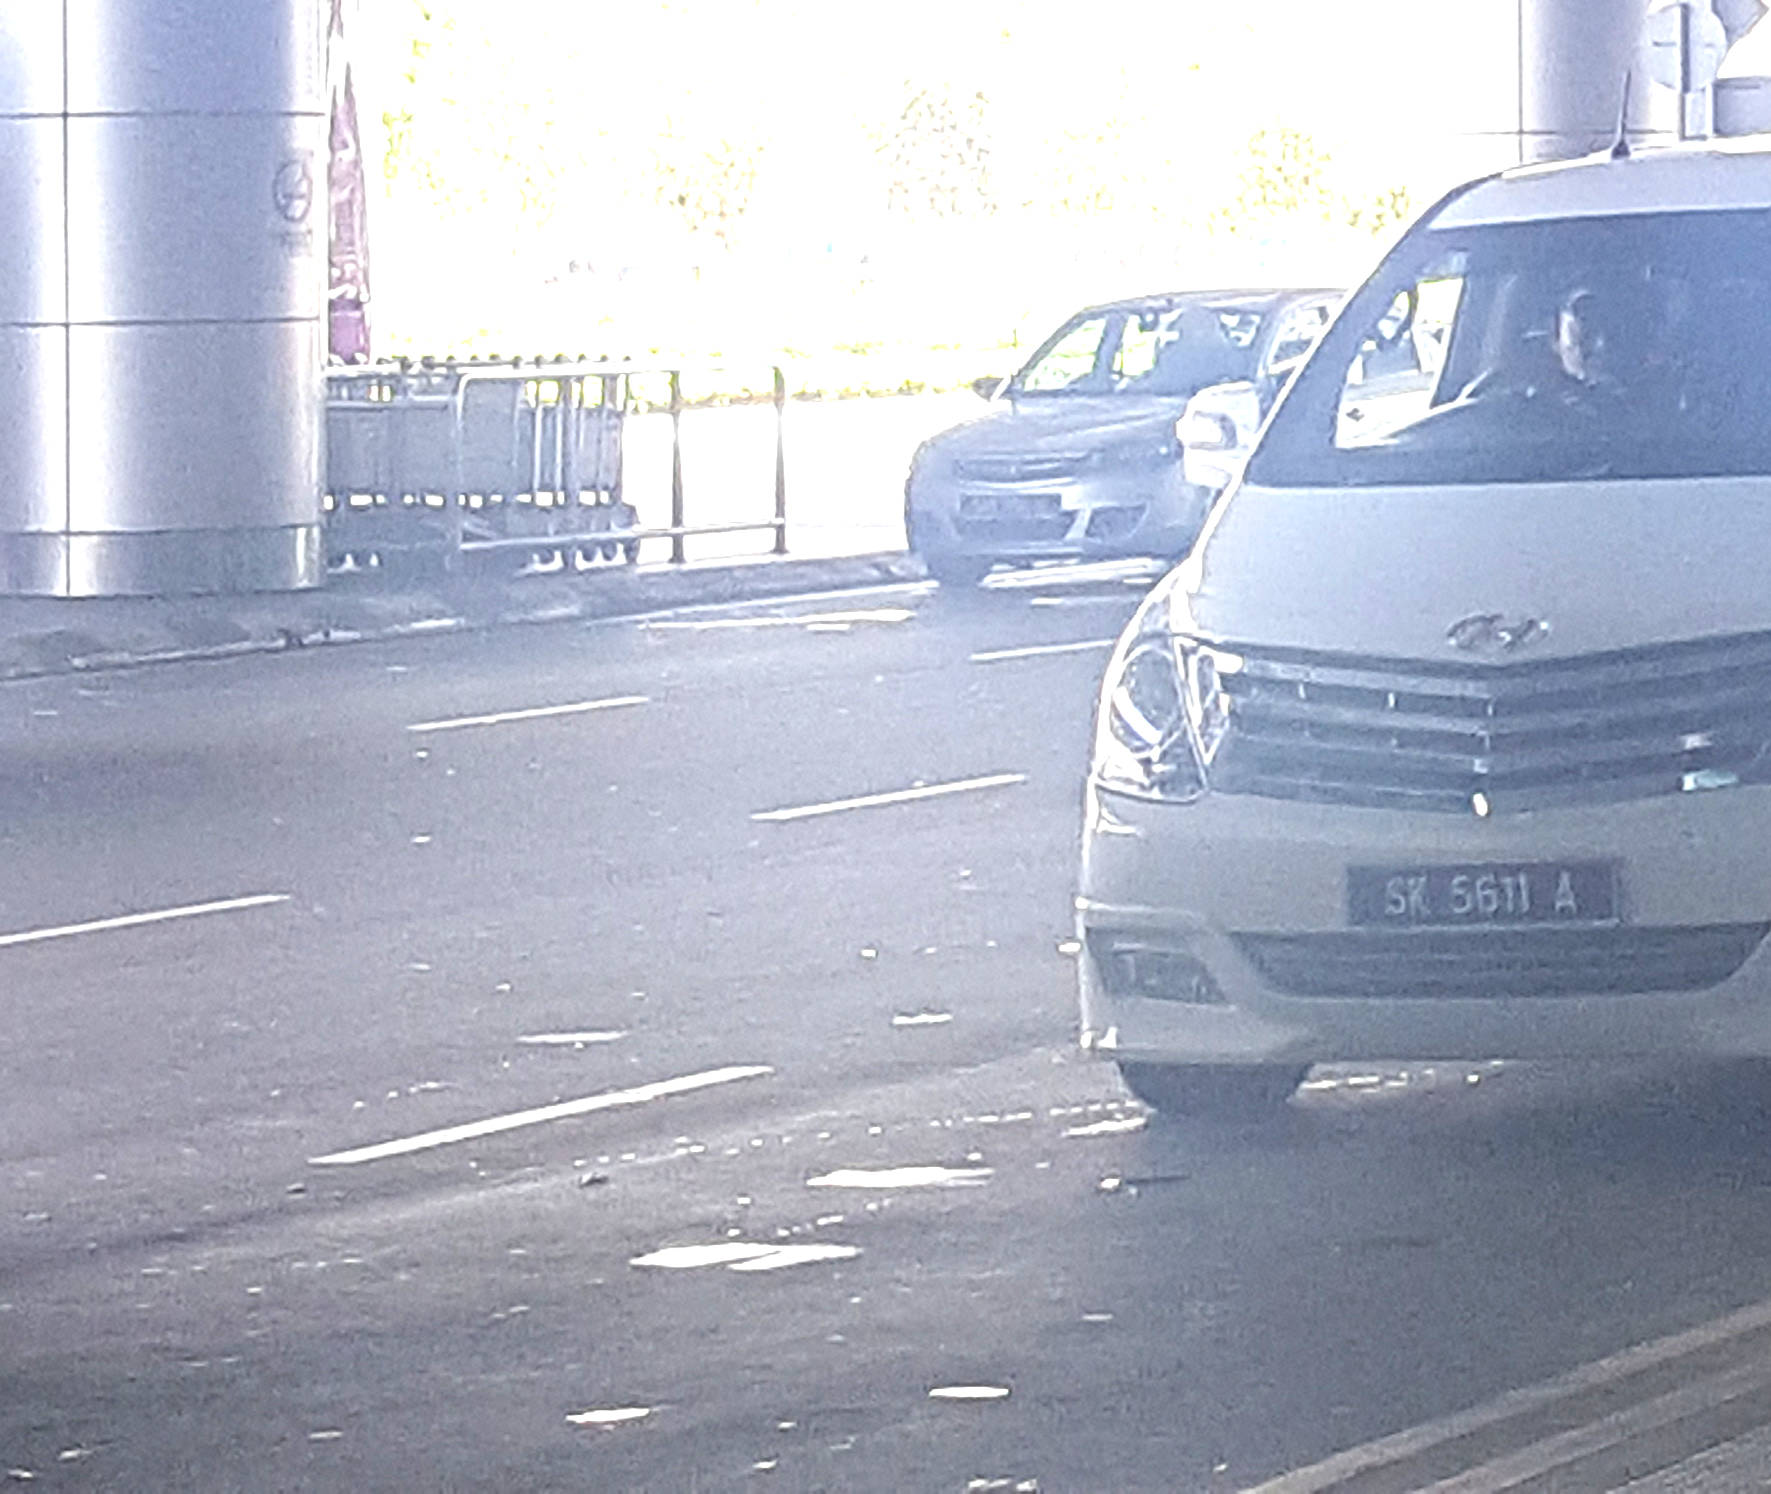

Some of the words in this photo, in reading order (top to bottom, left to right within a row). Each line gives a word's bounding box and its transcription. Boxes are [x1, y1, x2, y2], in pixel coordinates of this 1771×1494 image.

[1384, 873, 1432, 916] SK
[1450, 871, 1532, 915] 5611
[1554, 870, 1579, 915] A
